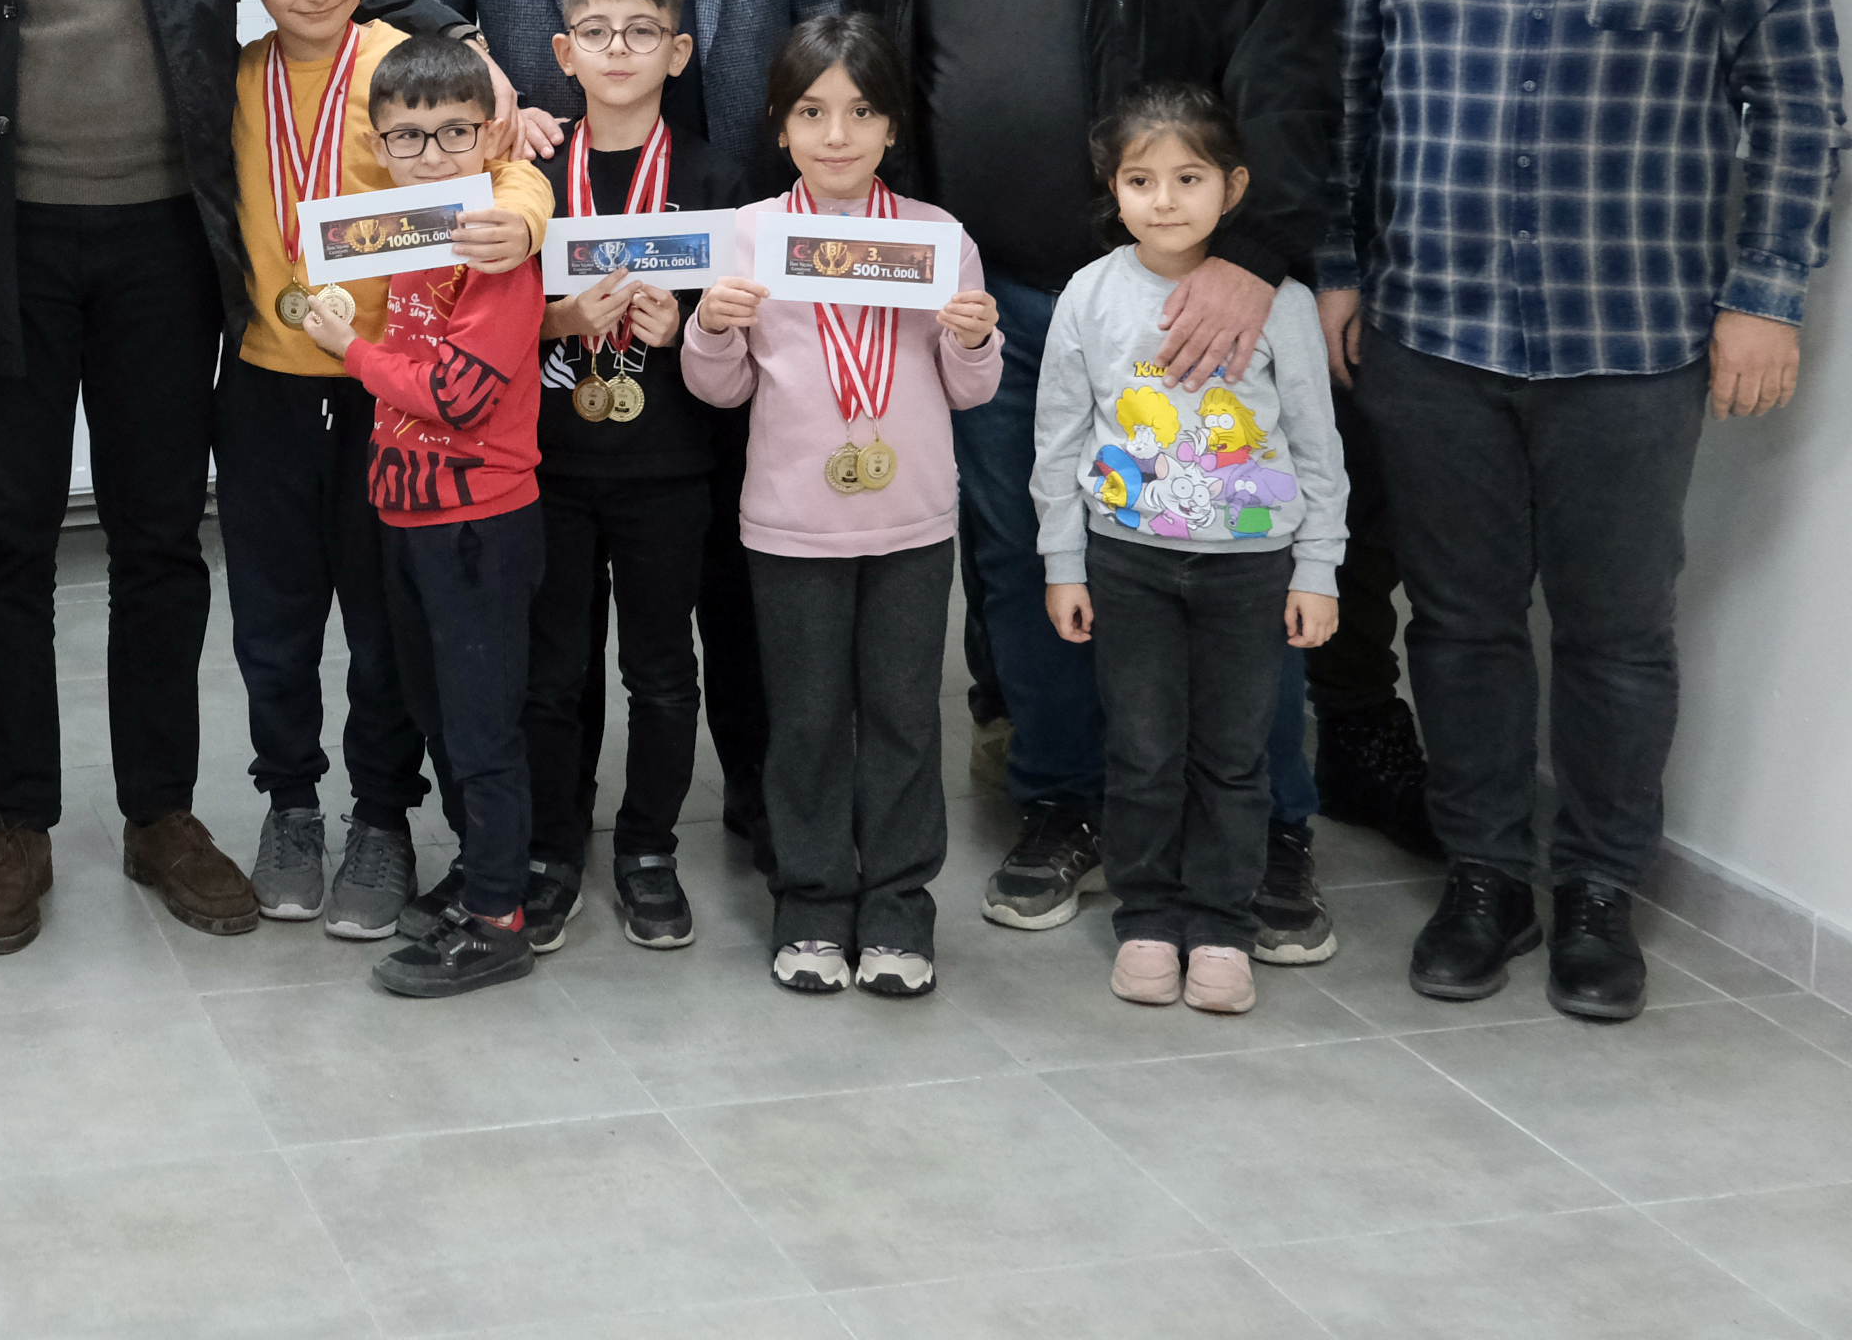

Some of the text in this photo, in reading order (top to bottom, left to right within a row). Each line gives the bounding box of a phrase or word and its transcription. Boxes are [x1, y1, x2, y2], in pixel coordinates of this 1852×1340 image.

[399, 217, 415, 231] 1.
[386, 232, 421, 248] 1000
[420, 233, 432, 243] TL
[644, 241, 659, 254] 2.
[867, 247, 882, 262] 3.
[633, 255, 697, 269] 750 TL ÖDÜL
[852, 263, 921, 279] 500 TL ÖDÜL
